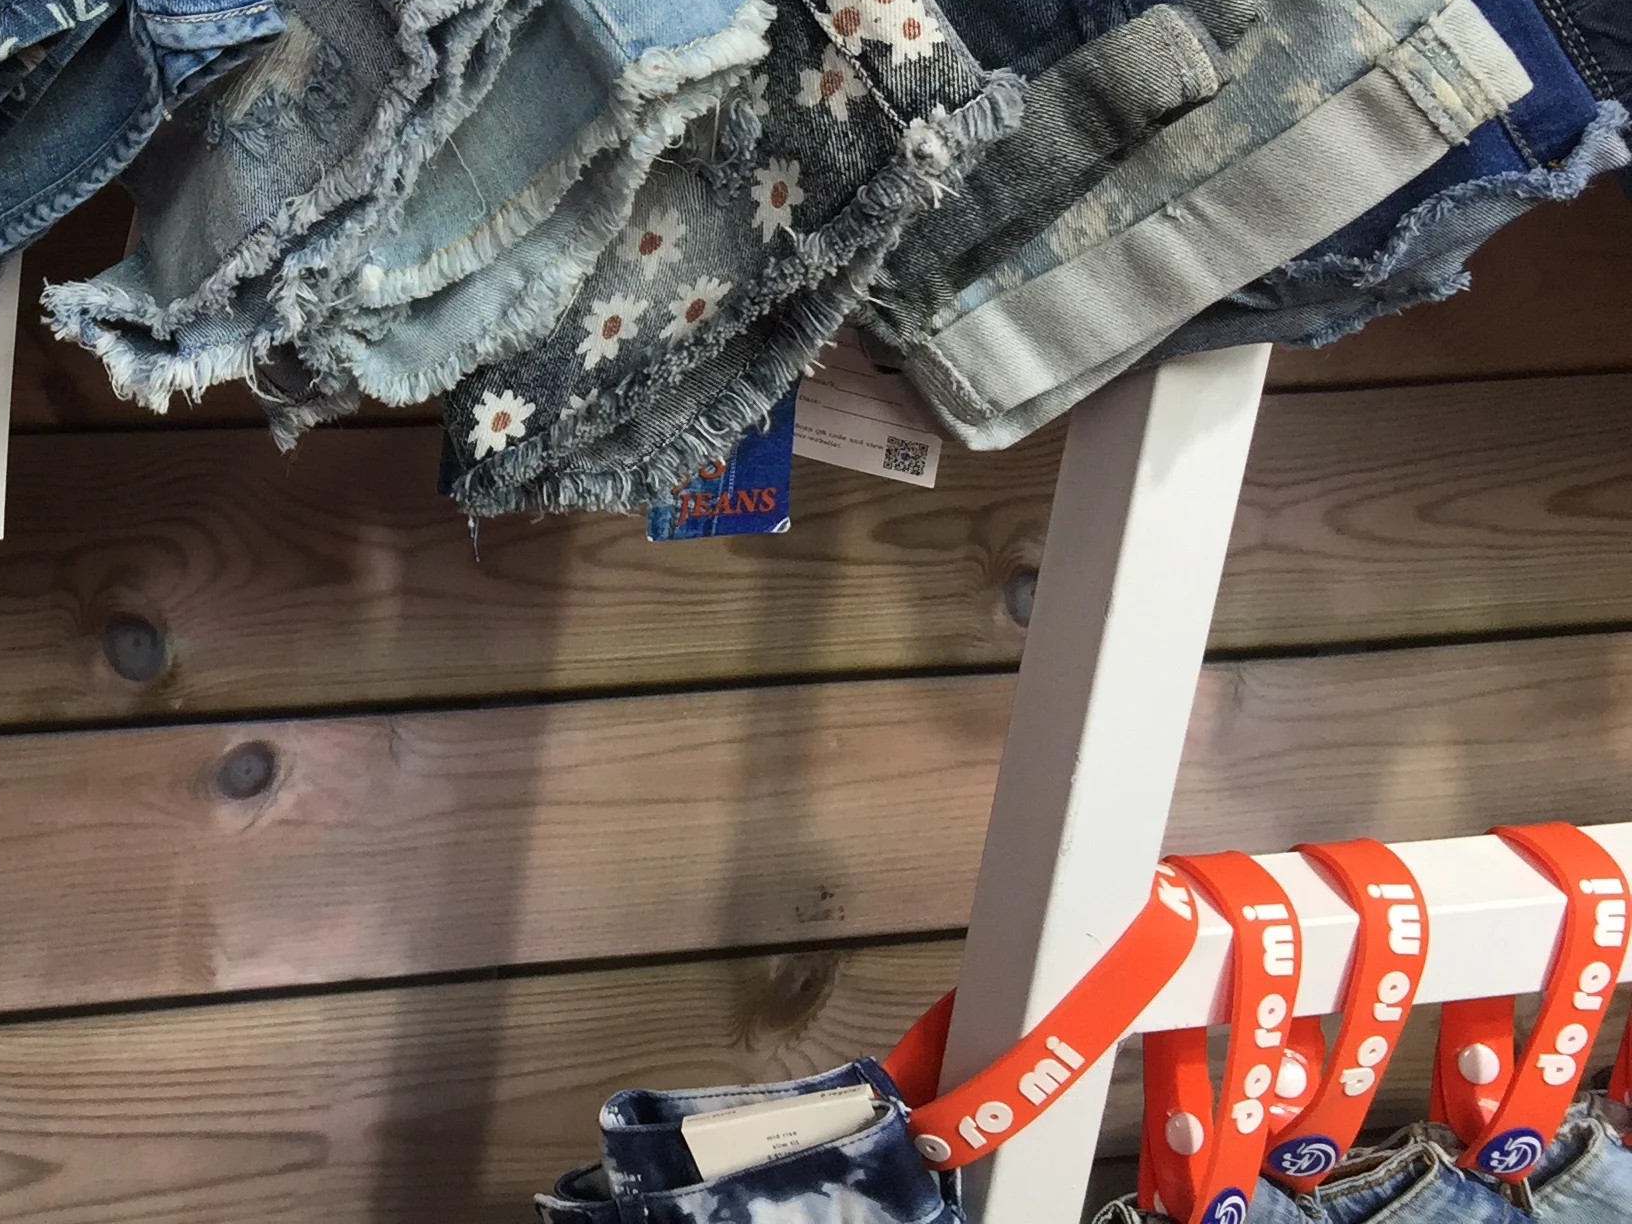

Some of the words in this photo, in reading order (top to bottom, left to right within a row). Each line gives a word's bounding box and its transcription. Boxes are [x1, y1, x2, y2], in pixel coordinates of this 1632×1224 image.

[676, 487, 777, 526] JEANS
[1241, 903, 1295, 976] mi
[1367, 883, 1421, 955] mi
[1579, 878, 1626, 947] mi
[1373, 971, 1411, 1021] ro
[1573, 961, 1611, 1010] ro
[1254, 993, 1287, 1048] ro
[1339, 1035, 1388, 1096] do
[1536, 1024, 1589, 1086] do
[914, 1133, 952, 1163] o
[959, 1102, 1014, 1148] ro
[1018, 1035, 1086, 1106] mi
[1231, 1064, 1272, 1134] do
